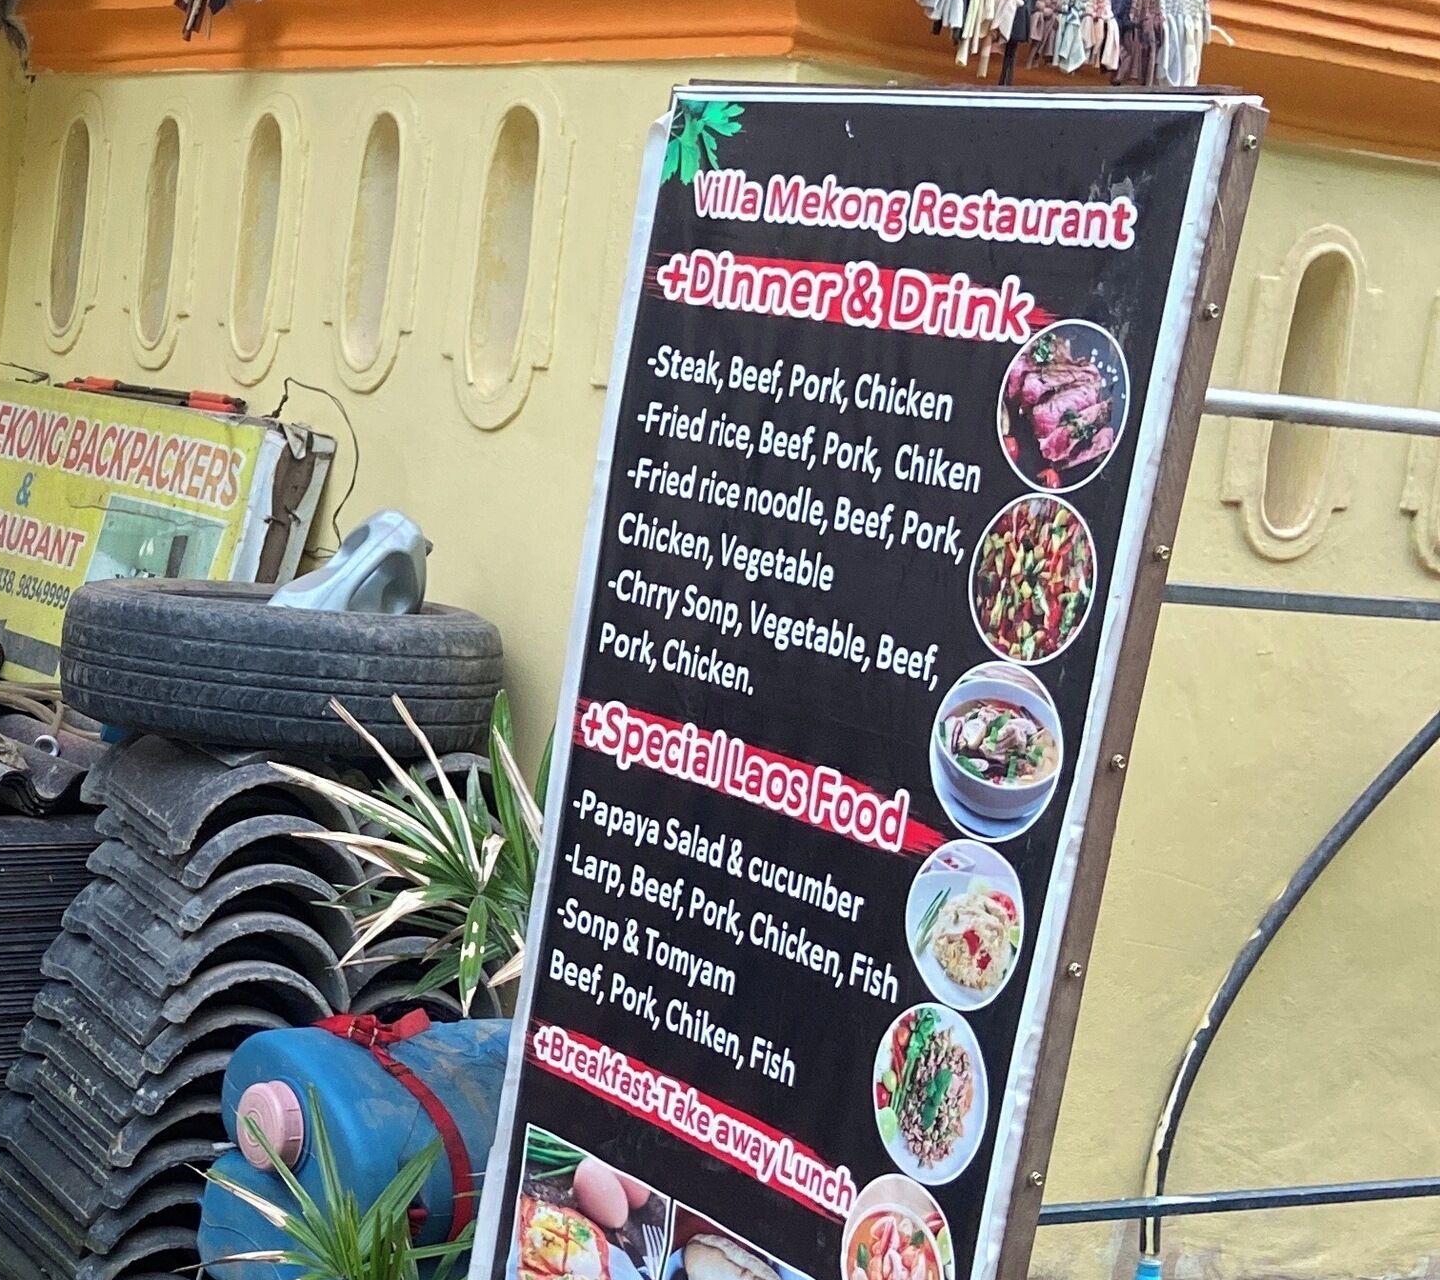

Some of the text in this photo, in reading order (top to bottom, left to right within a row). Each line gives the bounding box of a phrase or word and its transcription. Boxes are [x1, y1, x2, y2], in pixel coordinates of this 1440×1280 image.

[696, 172, 1134, 245] Villa Mekong Restaurant
[661, 254, 1032, 339] +Dinner & Drink
[647, 345, 953, 422] -Steak, Beef, Pork, Chicken
[15, 471, 34, 507] &
[62, 419, 243, 507] BACKPACKERS
[637, 402, 981, 493] -Fried rice, Beef, Pork, Chiken
[617, 512, 834, 591] Chicken, Vegetable
[627, 457, 965, 565] -Fried rice noodle, Beef, Pork,
[599, 622, 754, 696] Pork, Chicken.
[607, 569, 939, 691] -Chrry Sonp, Vegetable, Beef,
[584, 703, 908, 851] +Special Laos Food
[572, 789, 864, 922] -Papaya Salad & cucumber
[556, 897, 737, 996] -Sonp & Tomyam
[564, 843, 899, 1004] -Larp, Beef, Pork, Chicken, Fish
[548, 948, 796, 1087] Beef, Pork, Chiken, Fish
[714, 1116, 778, 1181] away
[780, 1138, 857, 1216] Lunch
